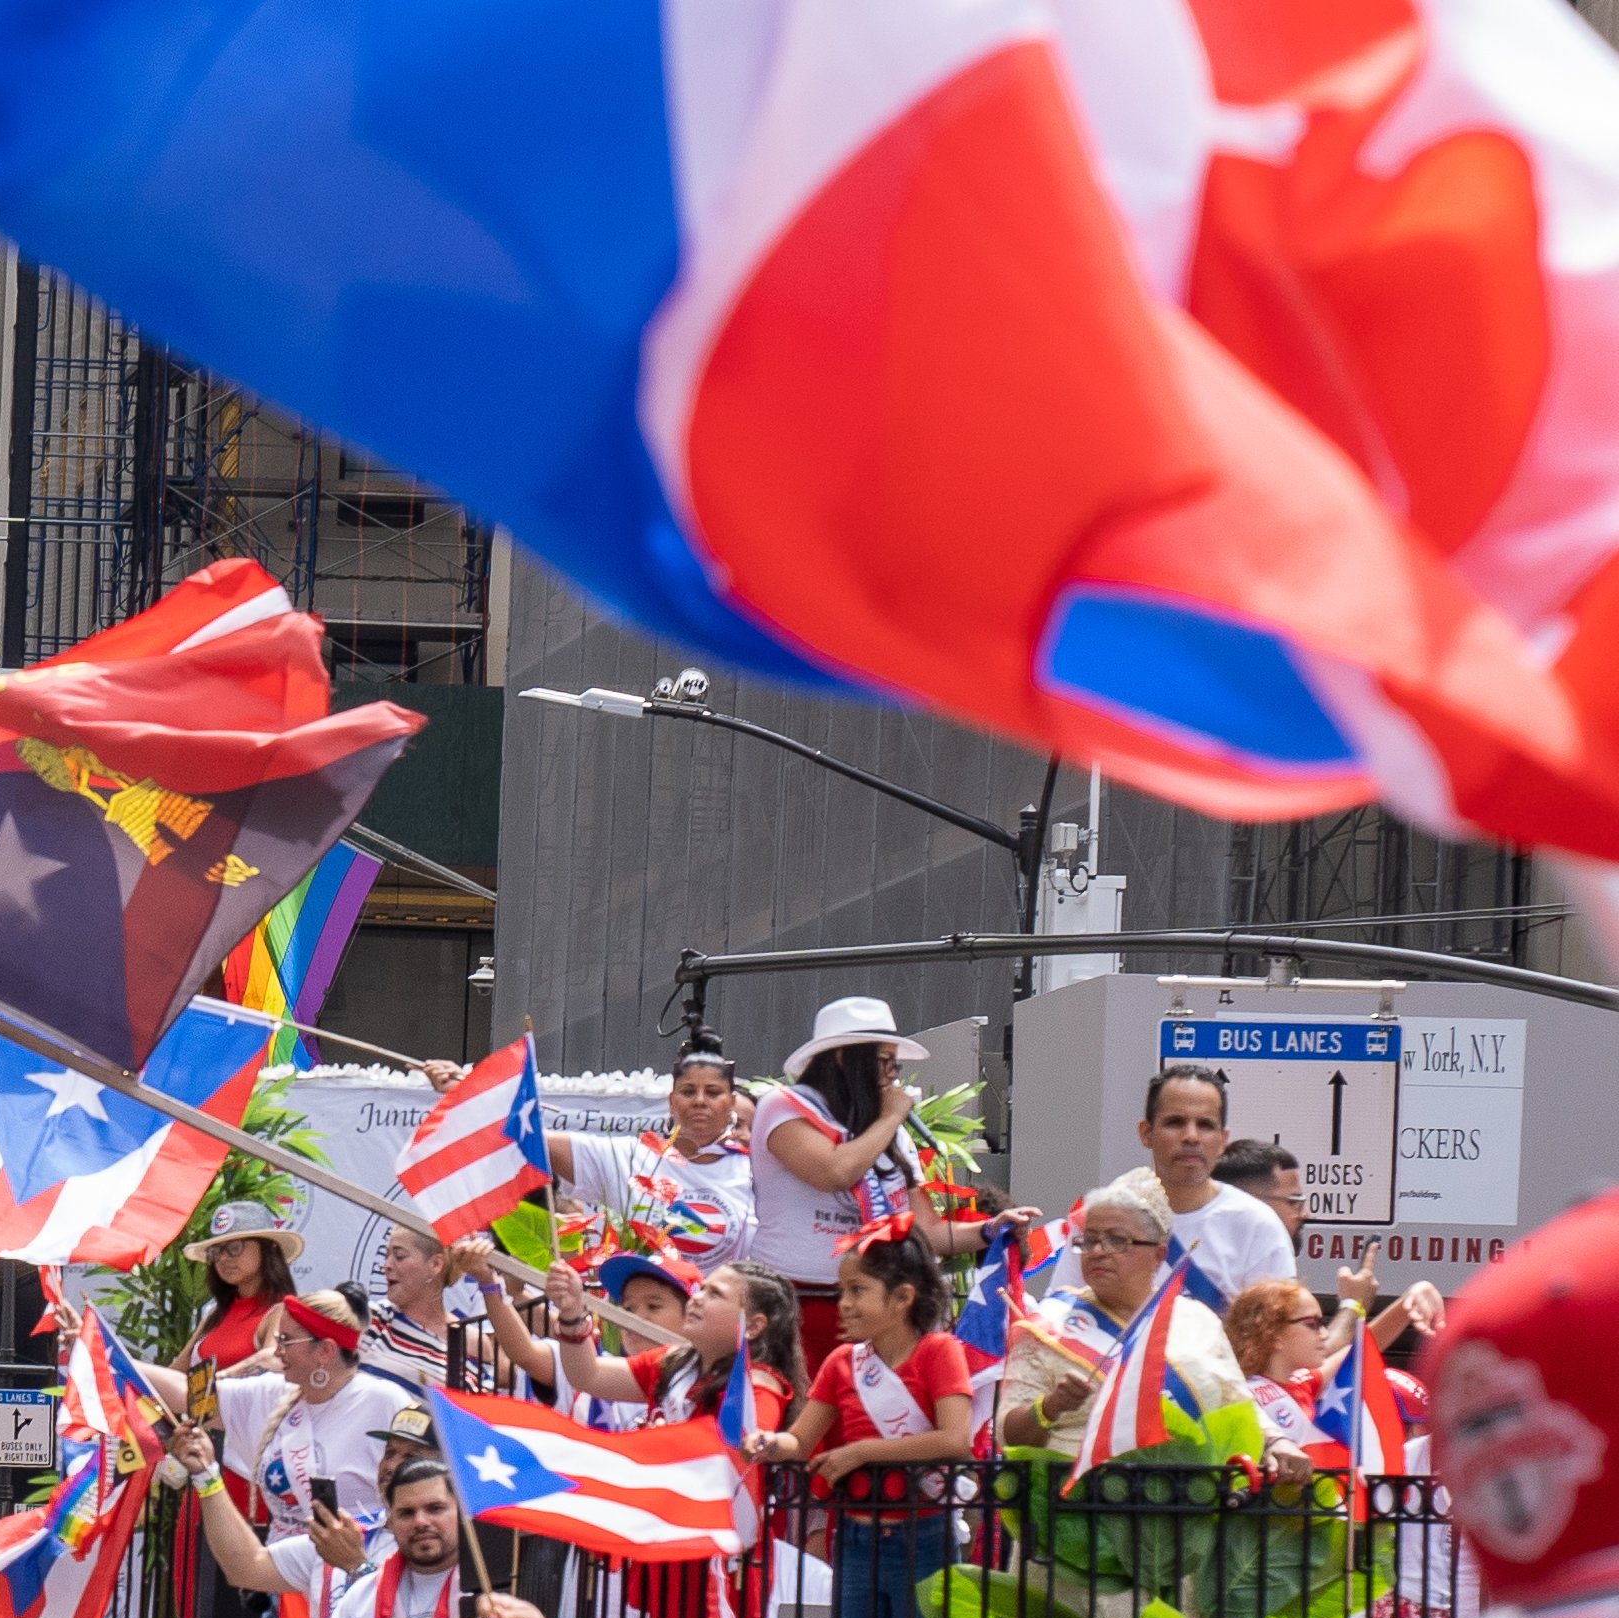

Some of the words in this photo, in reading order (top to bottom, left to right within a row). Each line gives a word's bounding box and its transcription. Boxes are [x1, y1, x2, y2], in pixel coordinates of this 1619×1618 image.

[1219, 1030, 1263, 1052] BUS
[1271, 1031, 1343, 1054] LANES
[1421, 1026, 1465, 1078] York,
[1471, 1033, 1506, 1074] N.Y.
[1306, 1163, 1363, 1186] BUSES
[1309, 1192, 1358, 1215] ONLY
[1295, 1233, 1505, 1264] CAFOLDING
[5, 1392, 32, 1403] LANES
[1, 1440, 23, 1451] BUSES
[24, 1441, 43, 1452] ONLY
[4, 1451, 24, 1462] RIGHT
[25, 1452, 48, 1463] TURNS
